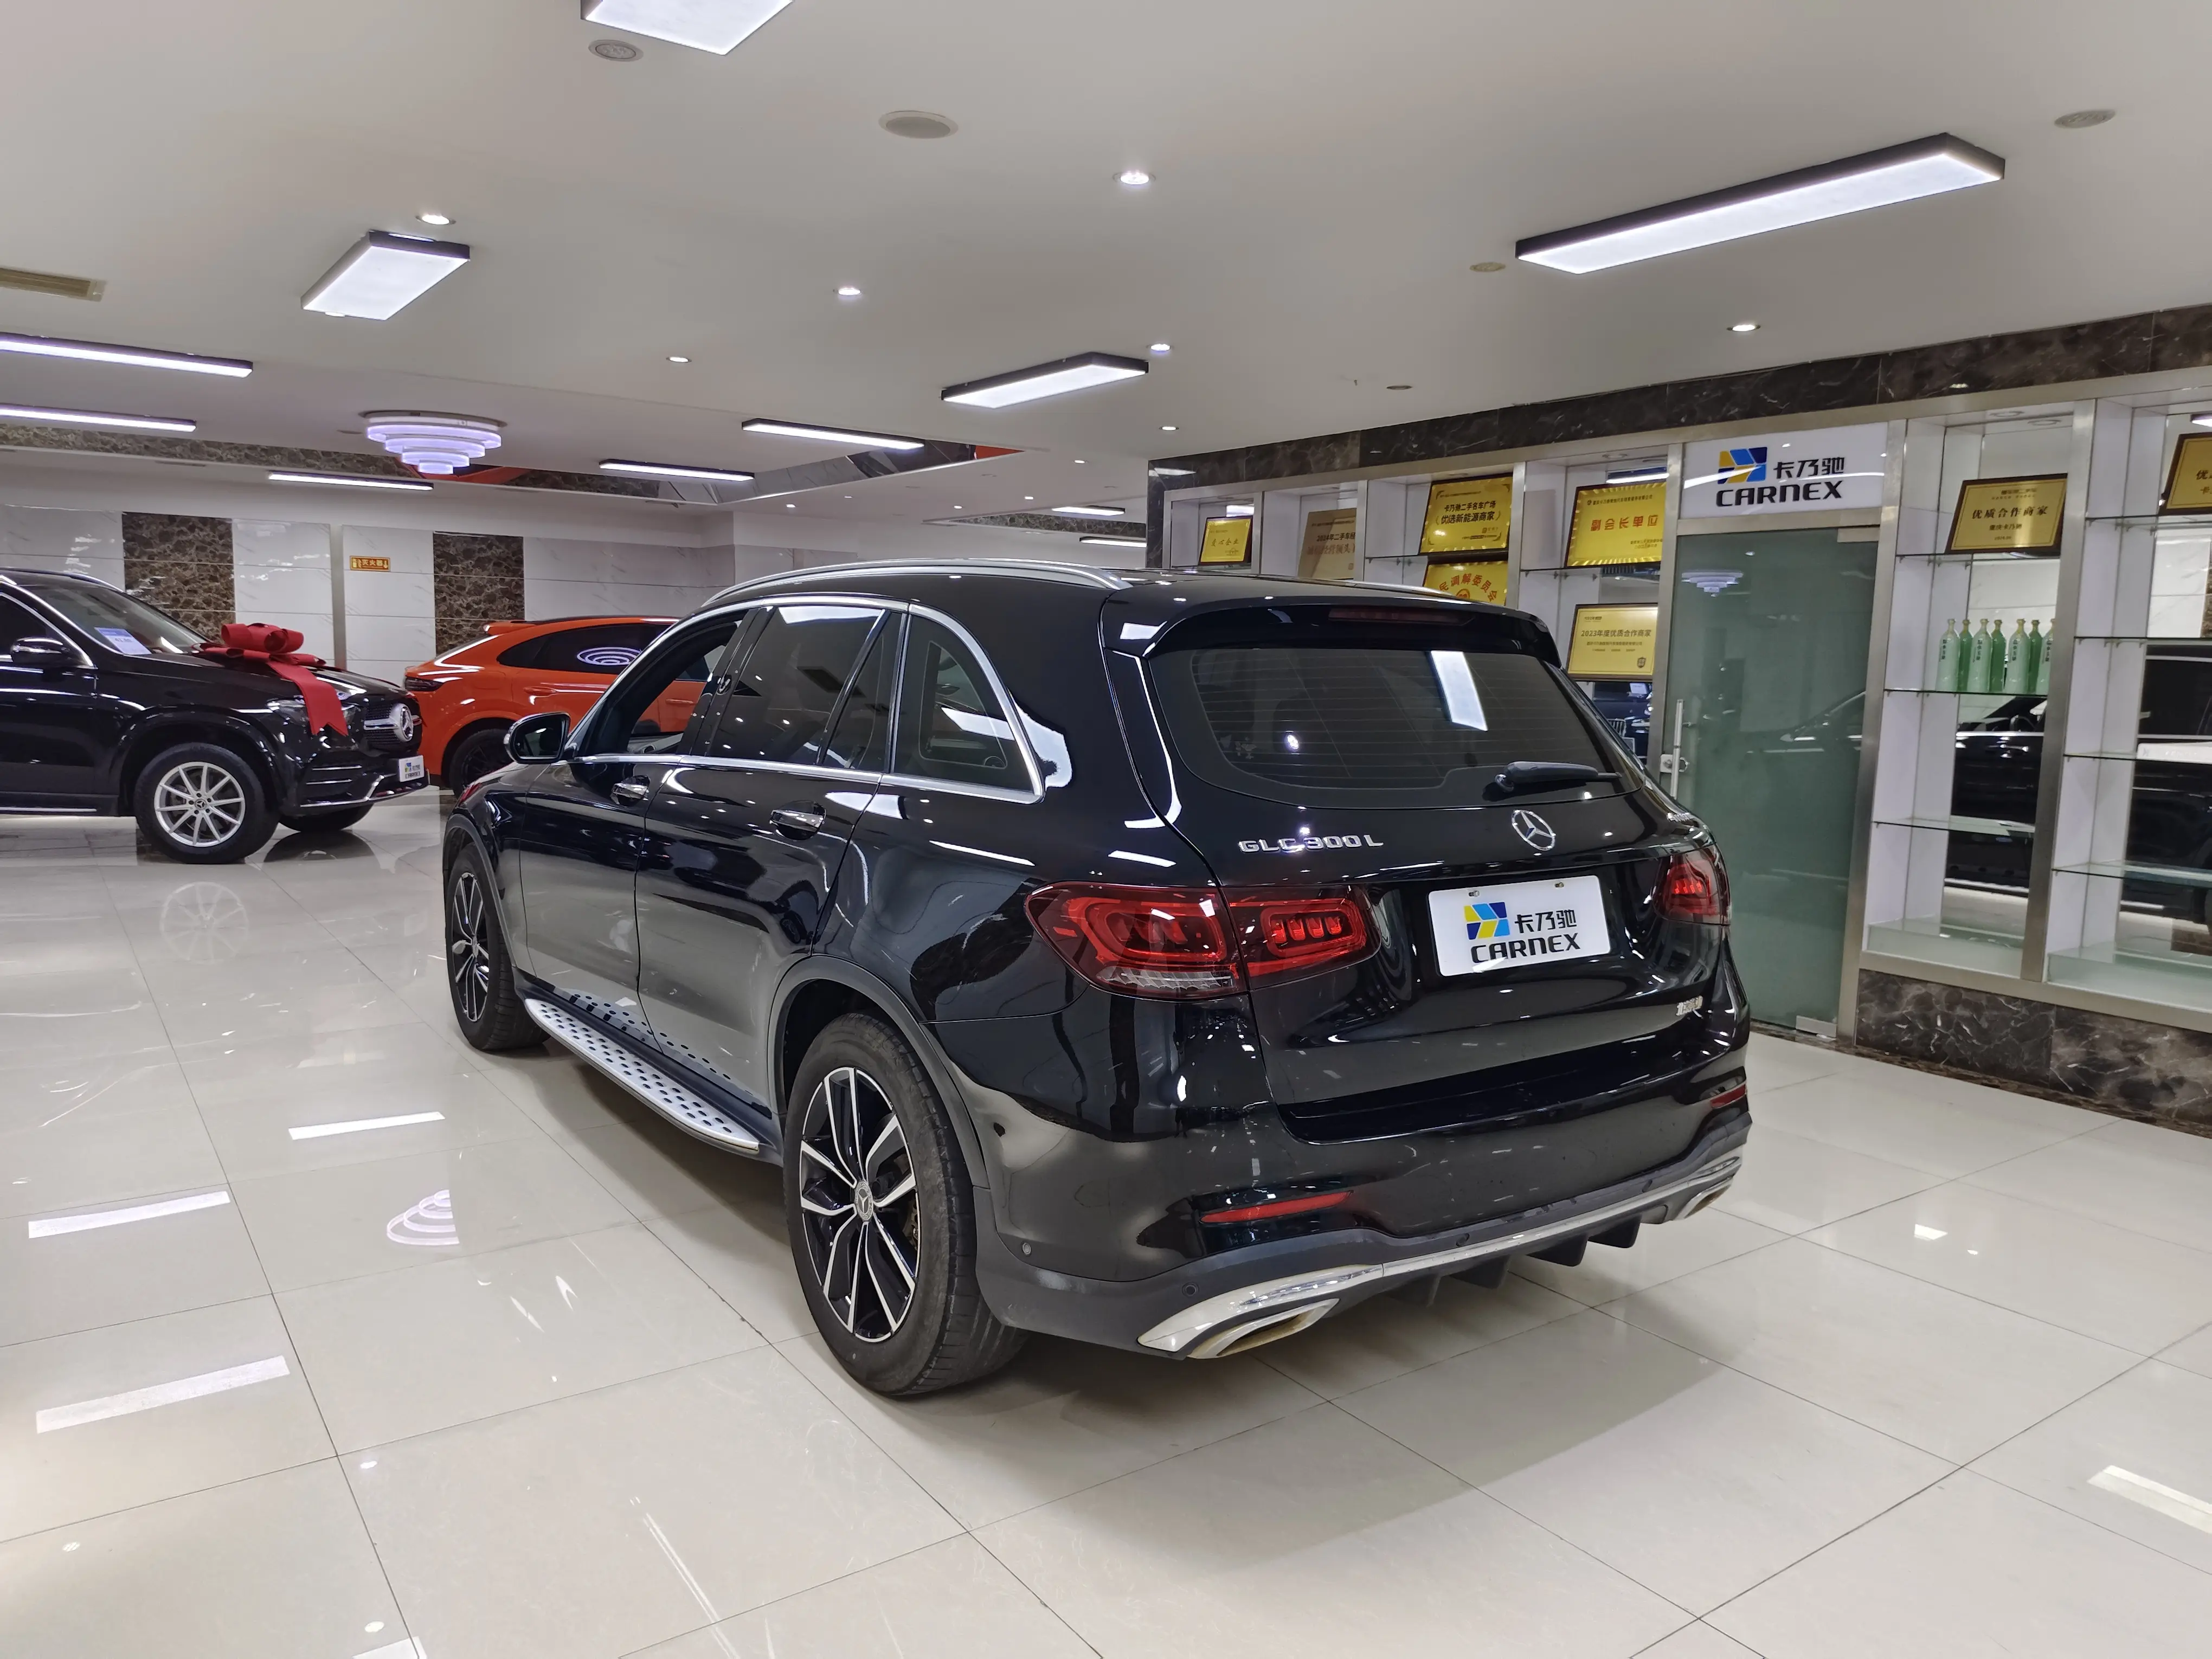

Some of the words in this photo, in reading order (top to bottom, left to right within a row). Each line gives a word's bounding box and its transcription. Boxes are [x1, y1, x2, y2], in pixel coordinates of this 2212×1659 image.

[1773, 457, 1844, 479] 卡乃驰
[1716, 480, 1843, 507] CARNEX
[1515, 909, 1577, 934] 卡乃驰
[1470, 933, 1580, 963] CARNEX
